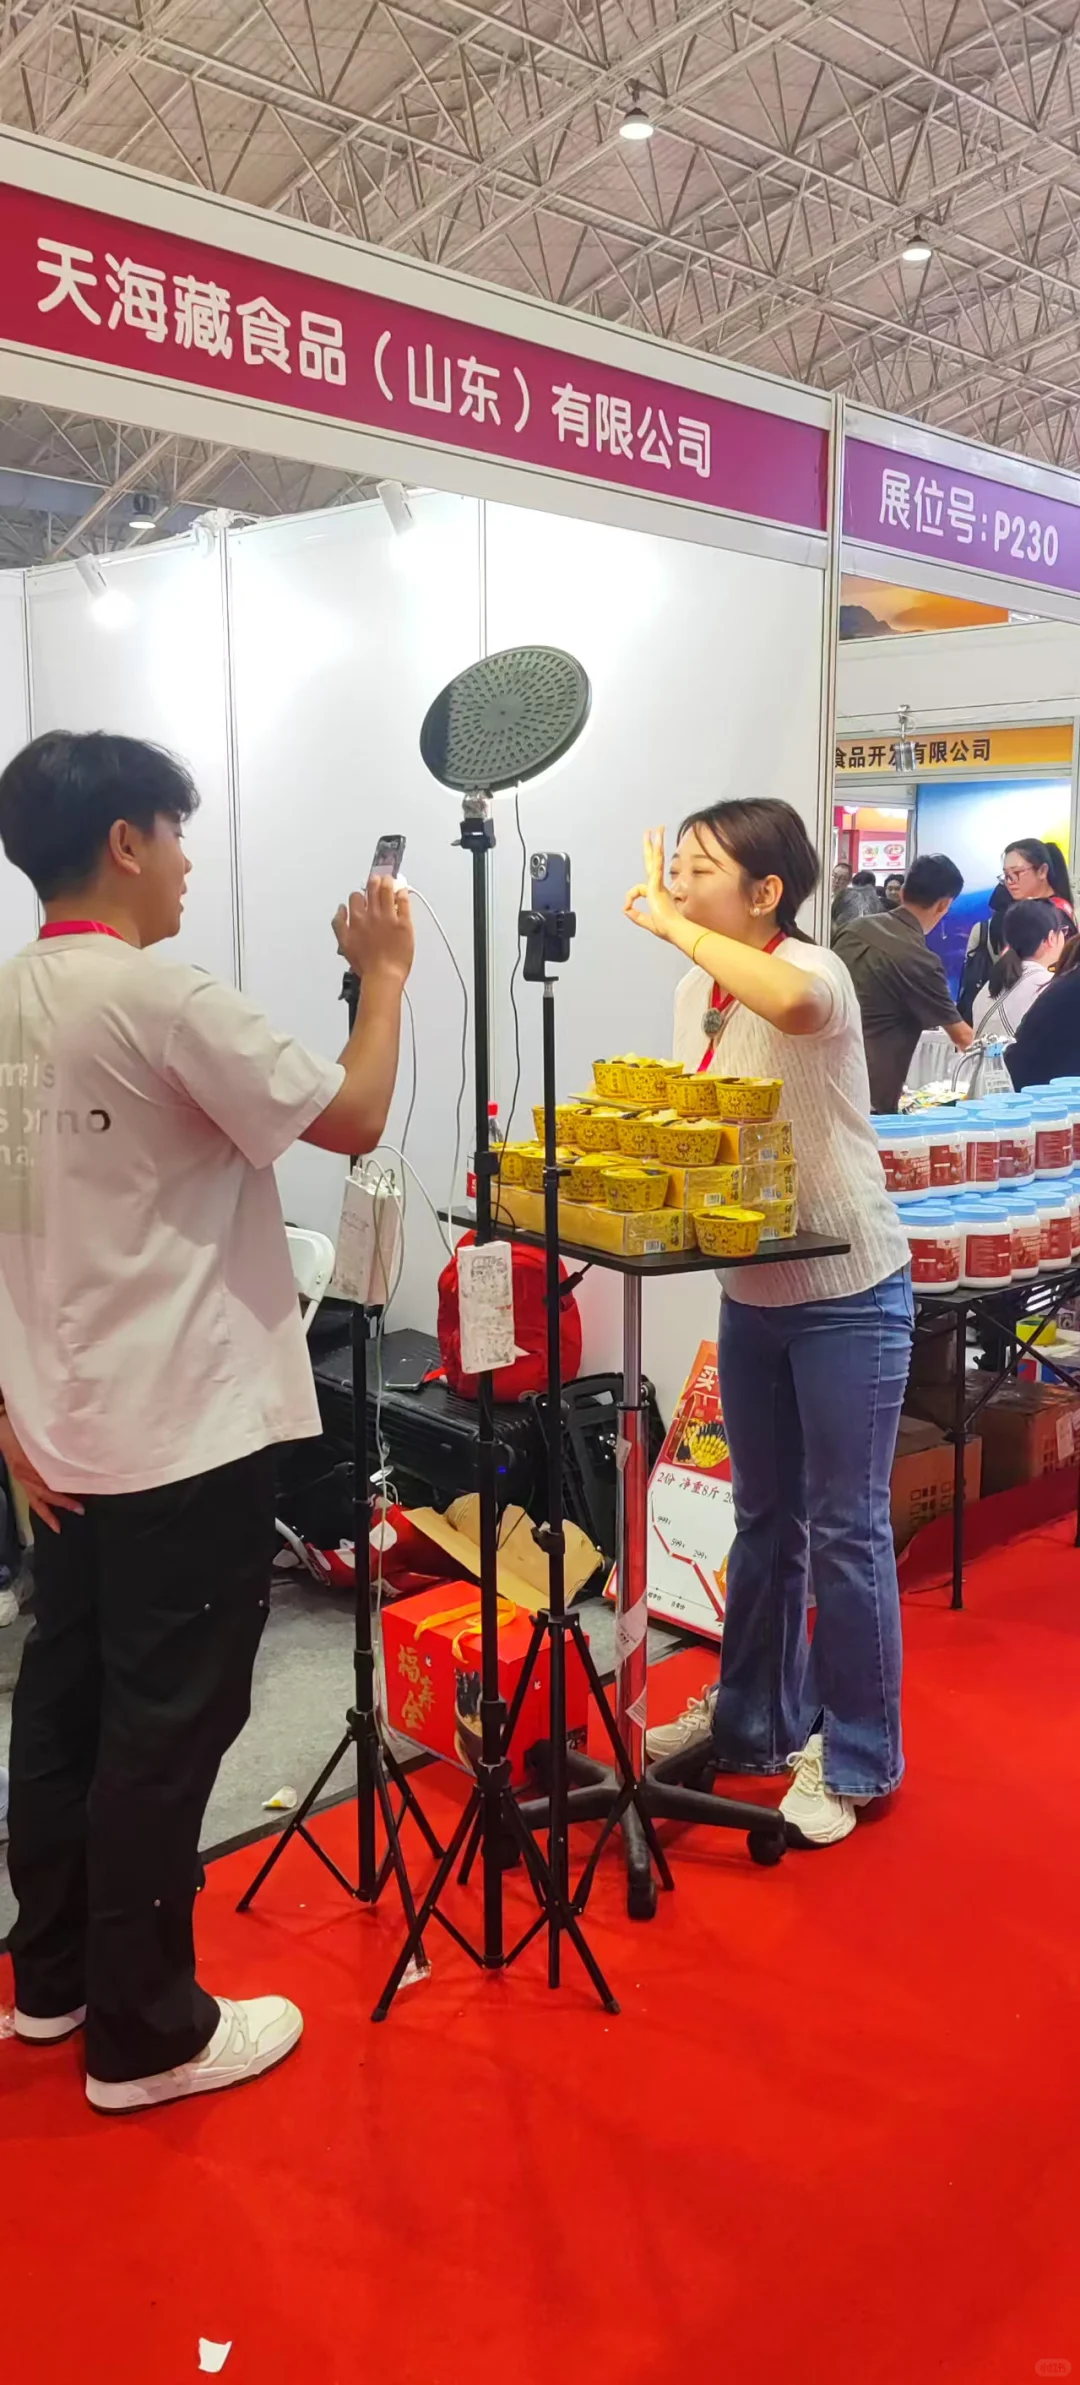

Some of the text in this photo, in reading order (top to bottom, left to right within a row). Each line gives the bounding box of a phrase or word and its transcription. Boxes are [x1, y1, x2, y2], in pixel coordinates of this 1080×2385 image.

[37, 237, 712, 478] 天海藏食品（山东）有限公司
